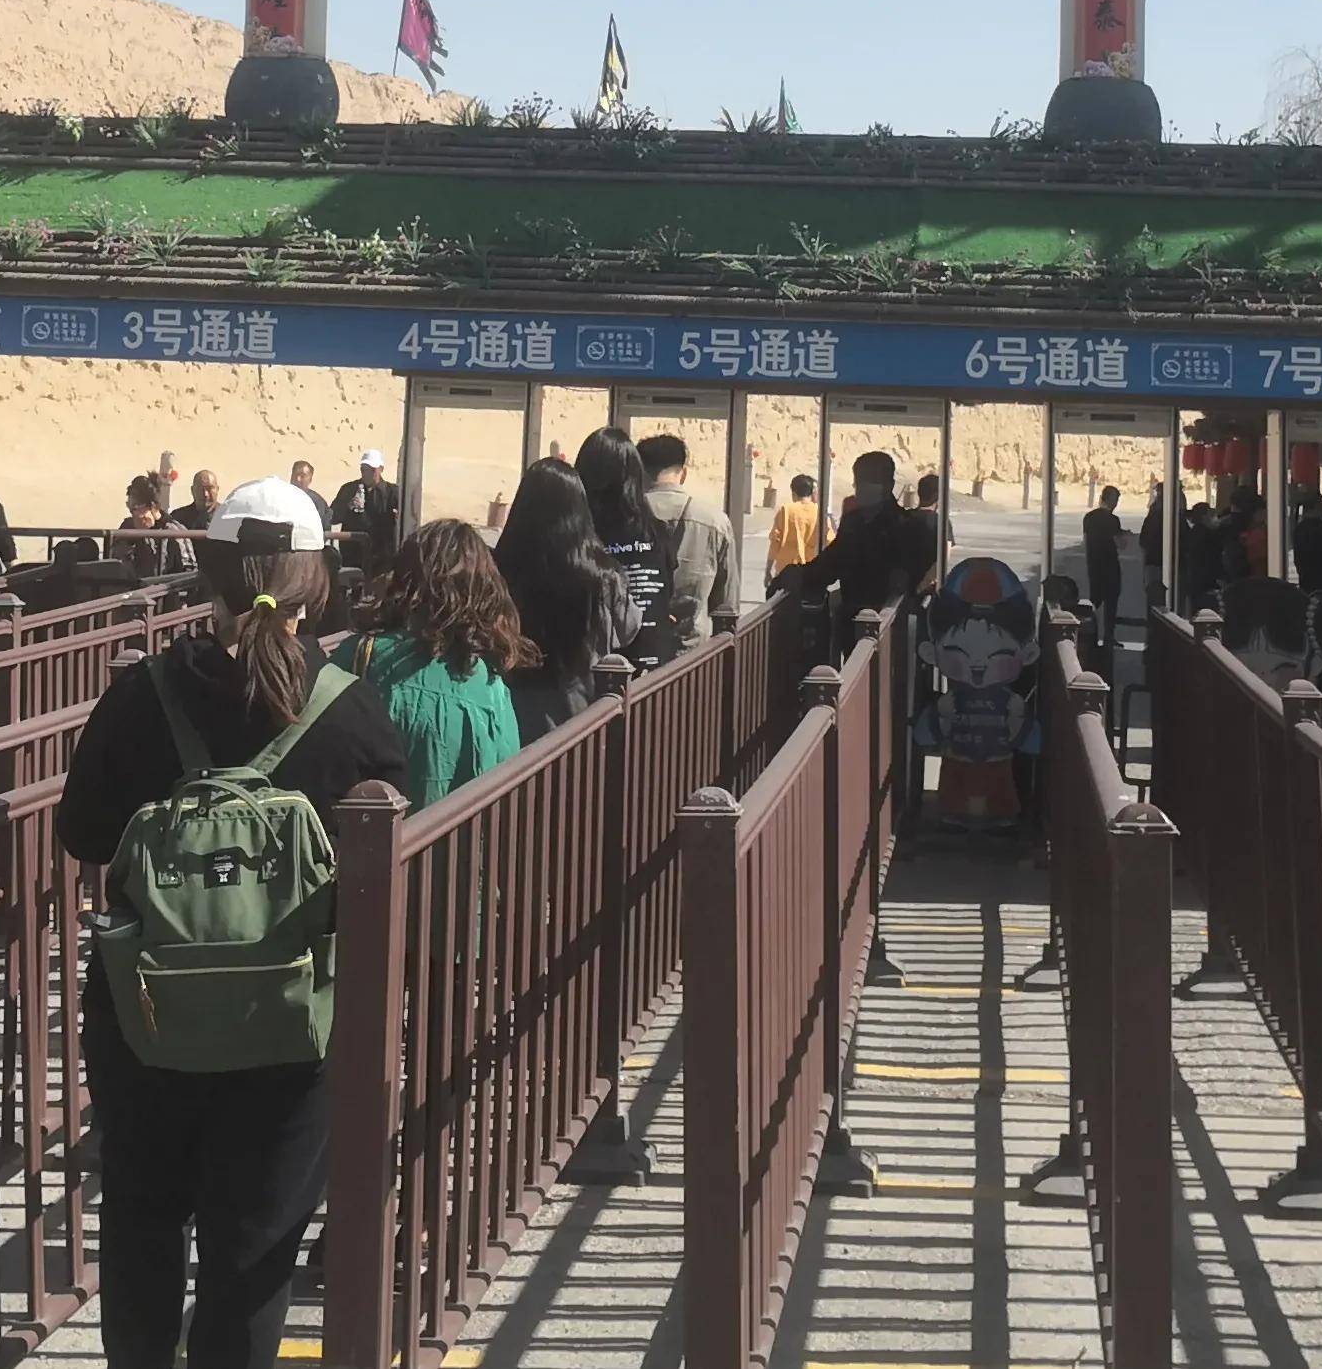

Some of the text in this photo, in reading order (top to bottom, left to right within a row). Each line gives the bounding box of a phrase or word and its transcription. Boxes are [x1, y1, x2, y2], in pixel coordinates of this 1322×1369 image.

[122, 308, 278, 360] 3号通道
[397, 318, 557, 371] 4号通道
[678, 328, 839, 380] 5号通道
[966, 336, 1129, 389] 6号通道
